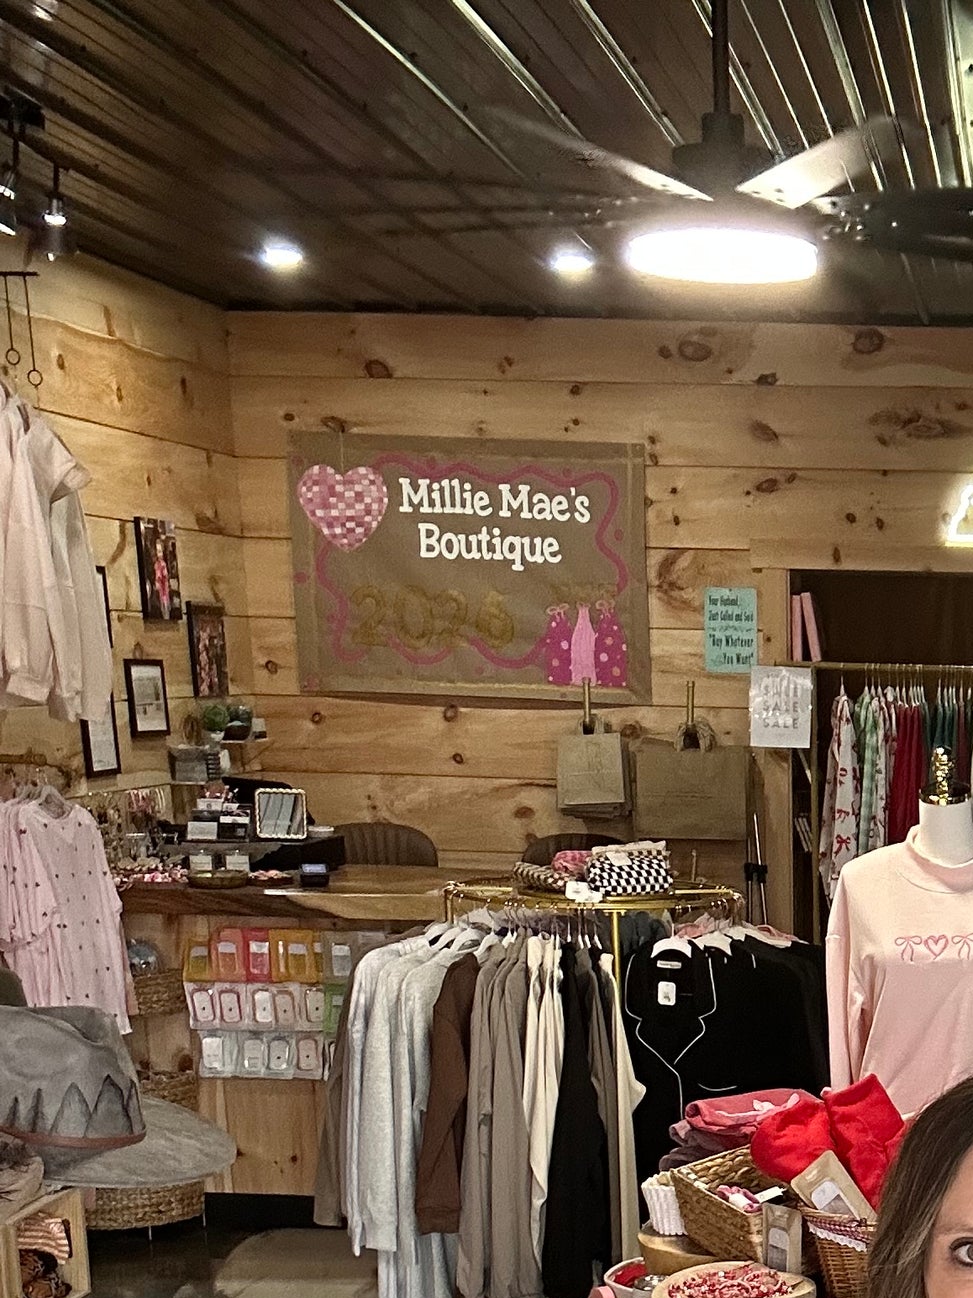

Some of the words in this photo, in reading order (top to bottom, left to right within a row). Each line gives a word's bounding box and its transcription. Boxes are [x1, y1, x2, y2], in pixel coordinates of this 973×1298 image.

[398, 477, 493, 517] Millie
[498, 484, 591, 523] Mae's
[417, 522, 563, 571] Boutique
[724, 634, 754, 648] Whatever
[763, 701, 799, 713] SALE
[763, 717, 799, 729] SALE
